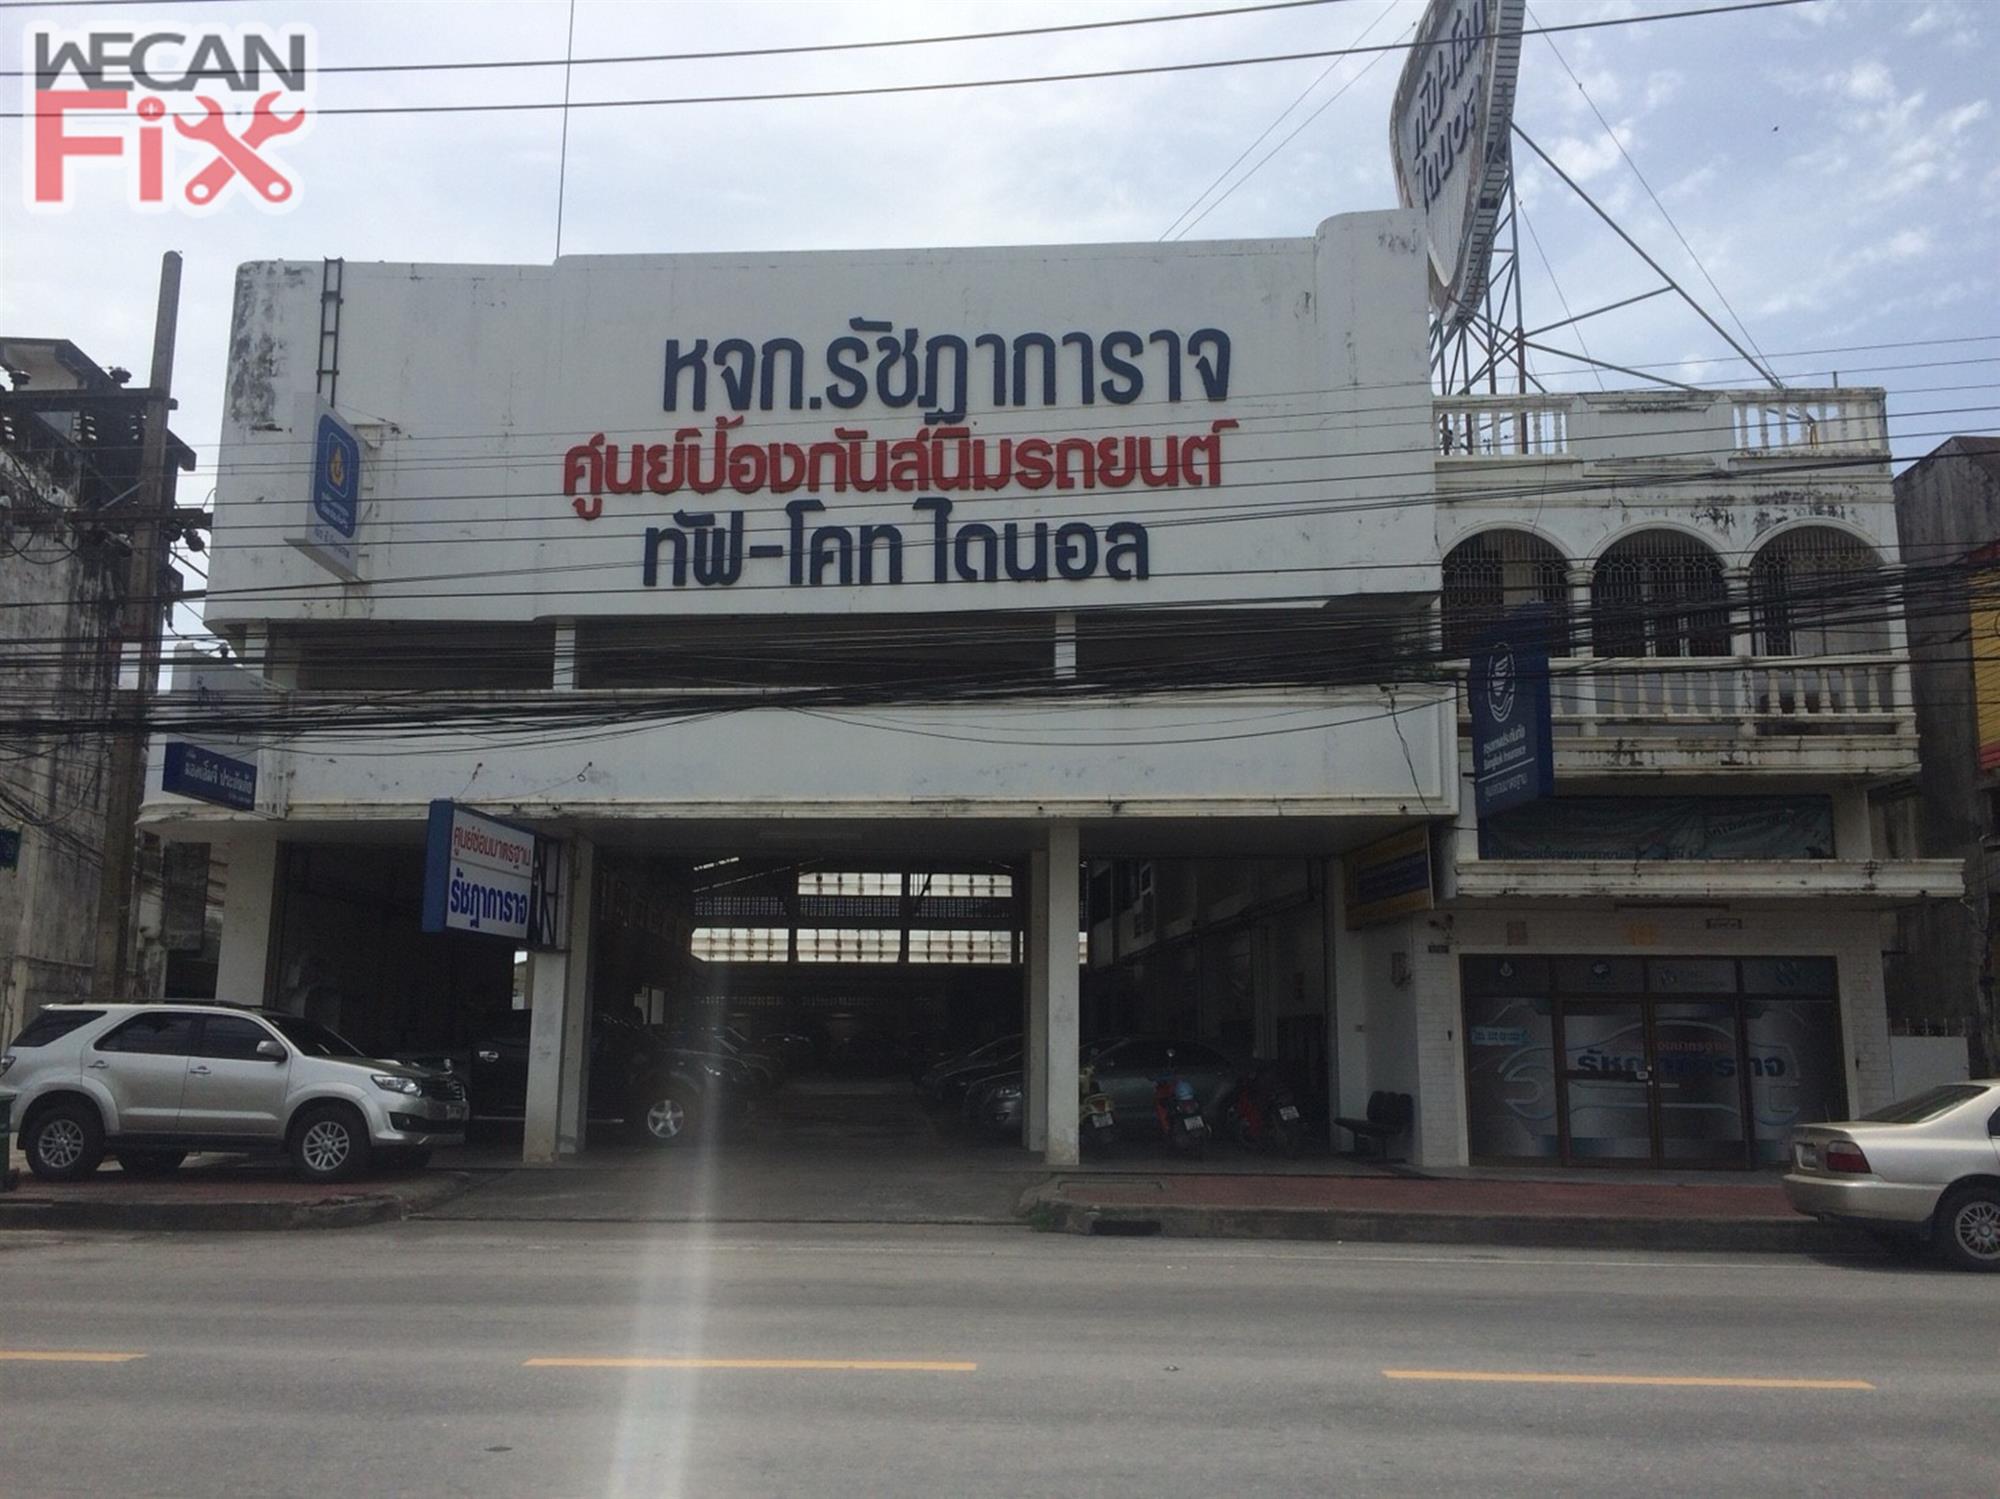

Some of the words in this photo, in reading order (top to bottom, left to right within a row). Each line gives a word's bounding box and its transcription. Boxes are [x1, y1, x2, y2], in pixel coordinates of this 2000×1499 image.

[663, 317, 1231, 424] หจก.รัชฎาการาจ
[564, 415, 1239, 521] ศูนย์ป้องกันสนิมรถยนต์
[450, 868, 528, 928] รัชฎาการาจ
